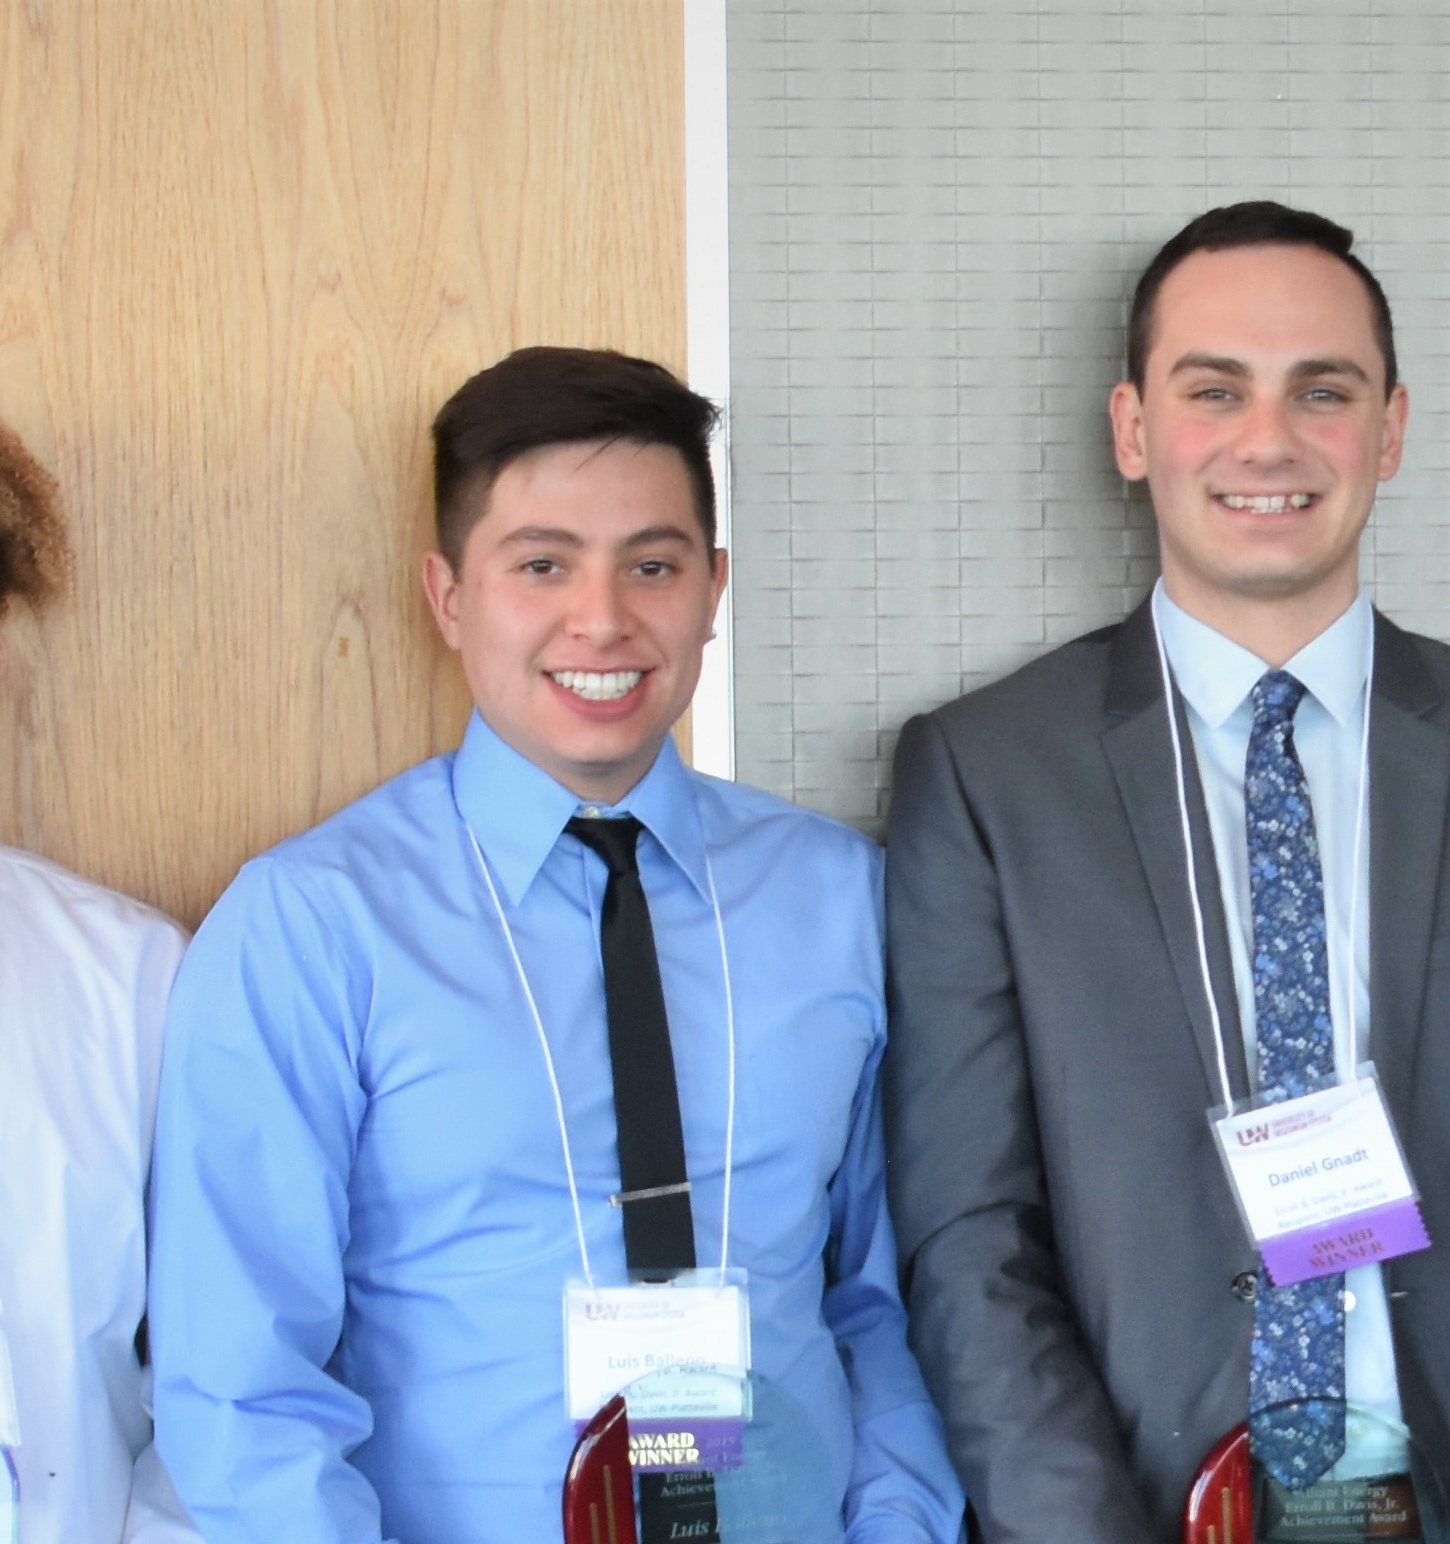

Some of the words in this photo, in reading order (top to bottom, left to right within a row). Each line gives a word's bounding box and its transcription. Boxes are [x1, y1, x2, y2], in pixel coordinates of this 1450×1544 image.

[1236, 1122, 1269, 1147] UW
[1268, 1161, 1318, 1187] Daniel
[1321, 1148, 1369, 1171] Gnadt
[1312, 1227, 1374, 1254] AWARD
[1310, 1240, 1385, 1268] WINNER
[608, 1354, 639, 1369] Luis
[630, 1432, 695, 1449] AWARD
[1343, 1483, 1388, 1499] Energy
[1386, 1498, 1400, 1511] Jr.
[1281, 1515, 1364, 1528] Achievement
[1369, 1510, 1407, 1523] Award
[670, 1520, 710, 1540] Luis
